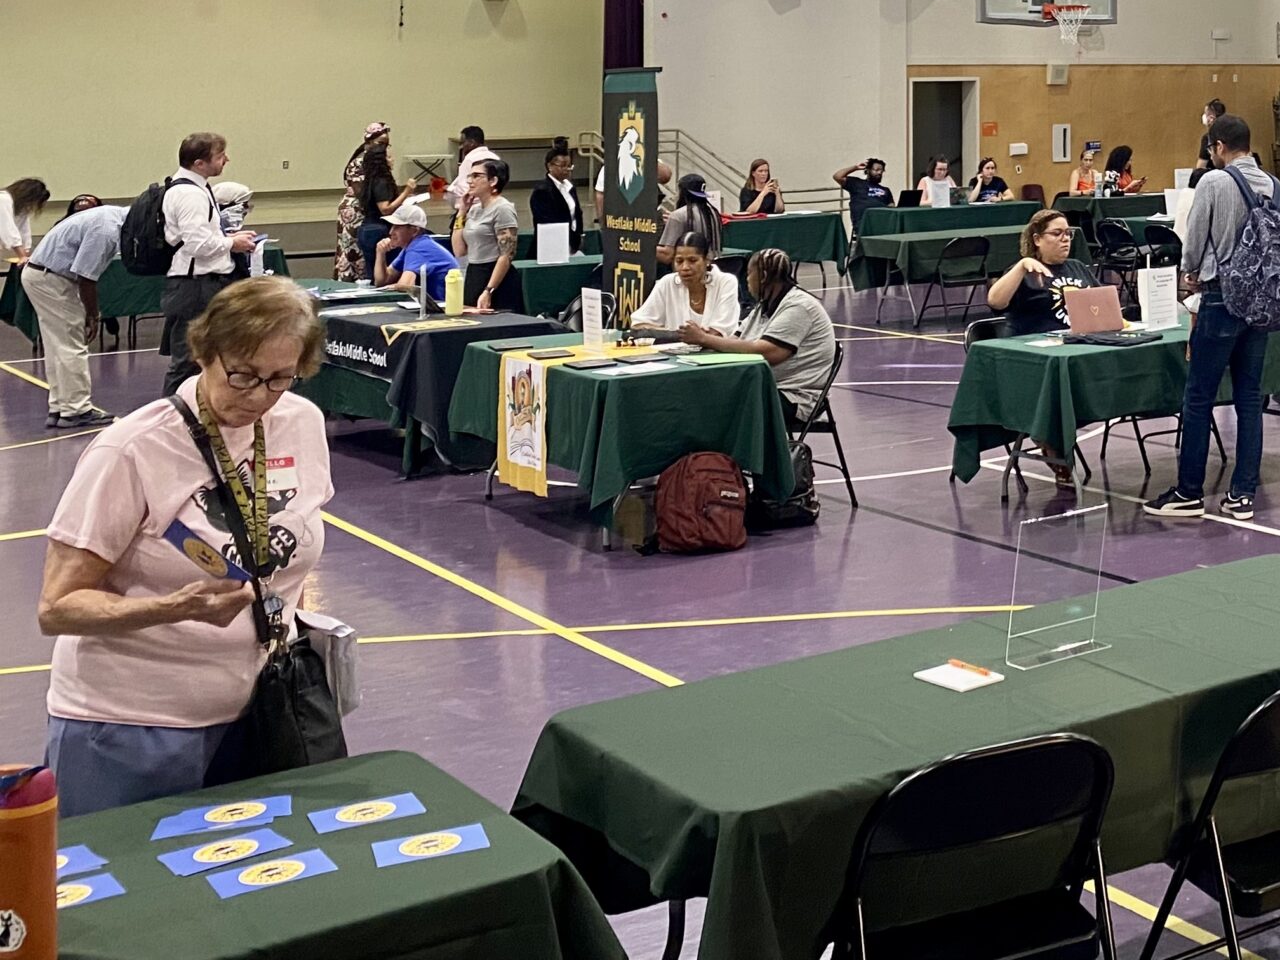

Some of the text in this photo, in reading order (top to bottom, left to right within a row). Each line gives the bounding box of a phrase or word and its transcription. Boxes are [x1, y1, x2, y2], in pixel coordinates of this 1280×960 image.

[606, 214, 657, 234] Westlake Middle
[619, 236, 641, 253] School
[346, 343, 368, 362] Middle
[368, 348, 387, 368] School
